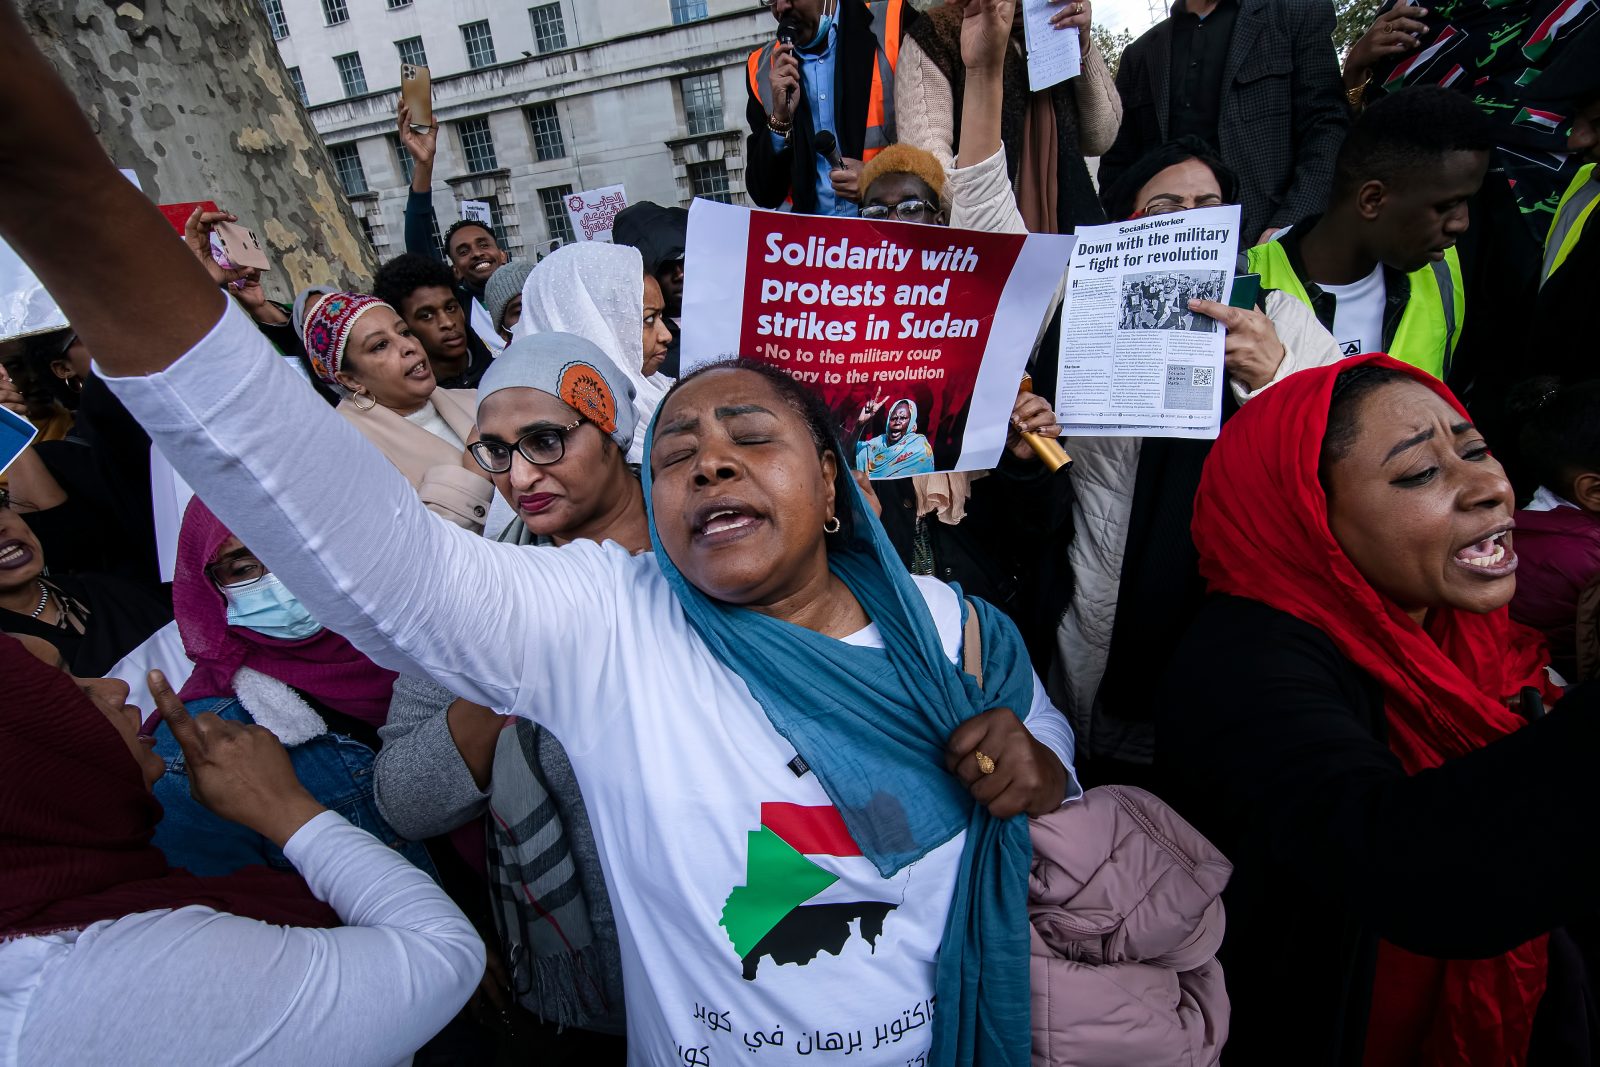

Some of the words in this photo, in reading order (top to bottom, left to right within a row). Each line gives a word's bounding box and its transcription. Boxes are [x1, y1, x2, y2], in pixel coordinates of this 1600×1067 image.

[764, 231, 914, 273] Solidarity
[920, 244, 980, 273] with
[1078, 242, 1112, 256] Down
[1116, 236, 1144, 252] with
[1148, 232, 1170, 247] the
[1174, 227, 1230, 244] military
[1088, 255, 1120, 273] fight
[1123, 253, 1144, 268] for
[1147, 246, 1219, 264] revolution
[760, 277, 886, 307] protests
[893, 278, 951, 306] and
[756, 311, 857, 342] strikes
[865, 313, 890, 341] in
[897, 311, 980, 340] Sudan
[764, 342, 791, 361] No
[795, 348, 815, 363] to
[819, 348, 845, 365] the
[849, 346, 904, 364] military
[906, 346, 942, 362] coup
[824, 369, 842, 385] to
[846, 369, 869, 384] the
[872, 366, 945, 383] revolution
[693, 1002, 732, 1033] كوبر
[872, 999, 931, 1050] اكتوبر
[744, 1024, 784, 1053] في
[796, 1030, 863, 1056] برهان
